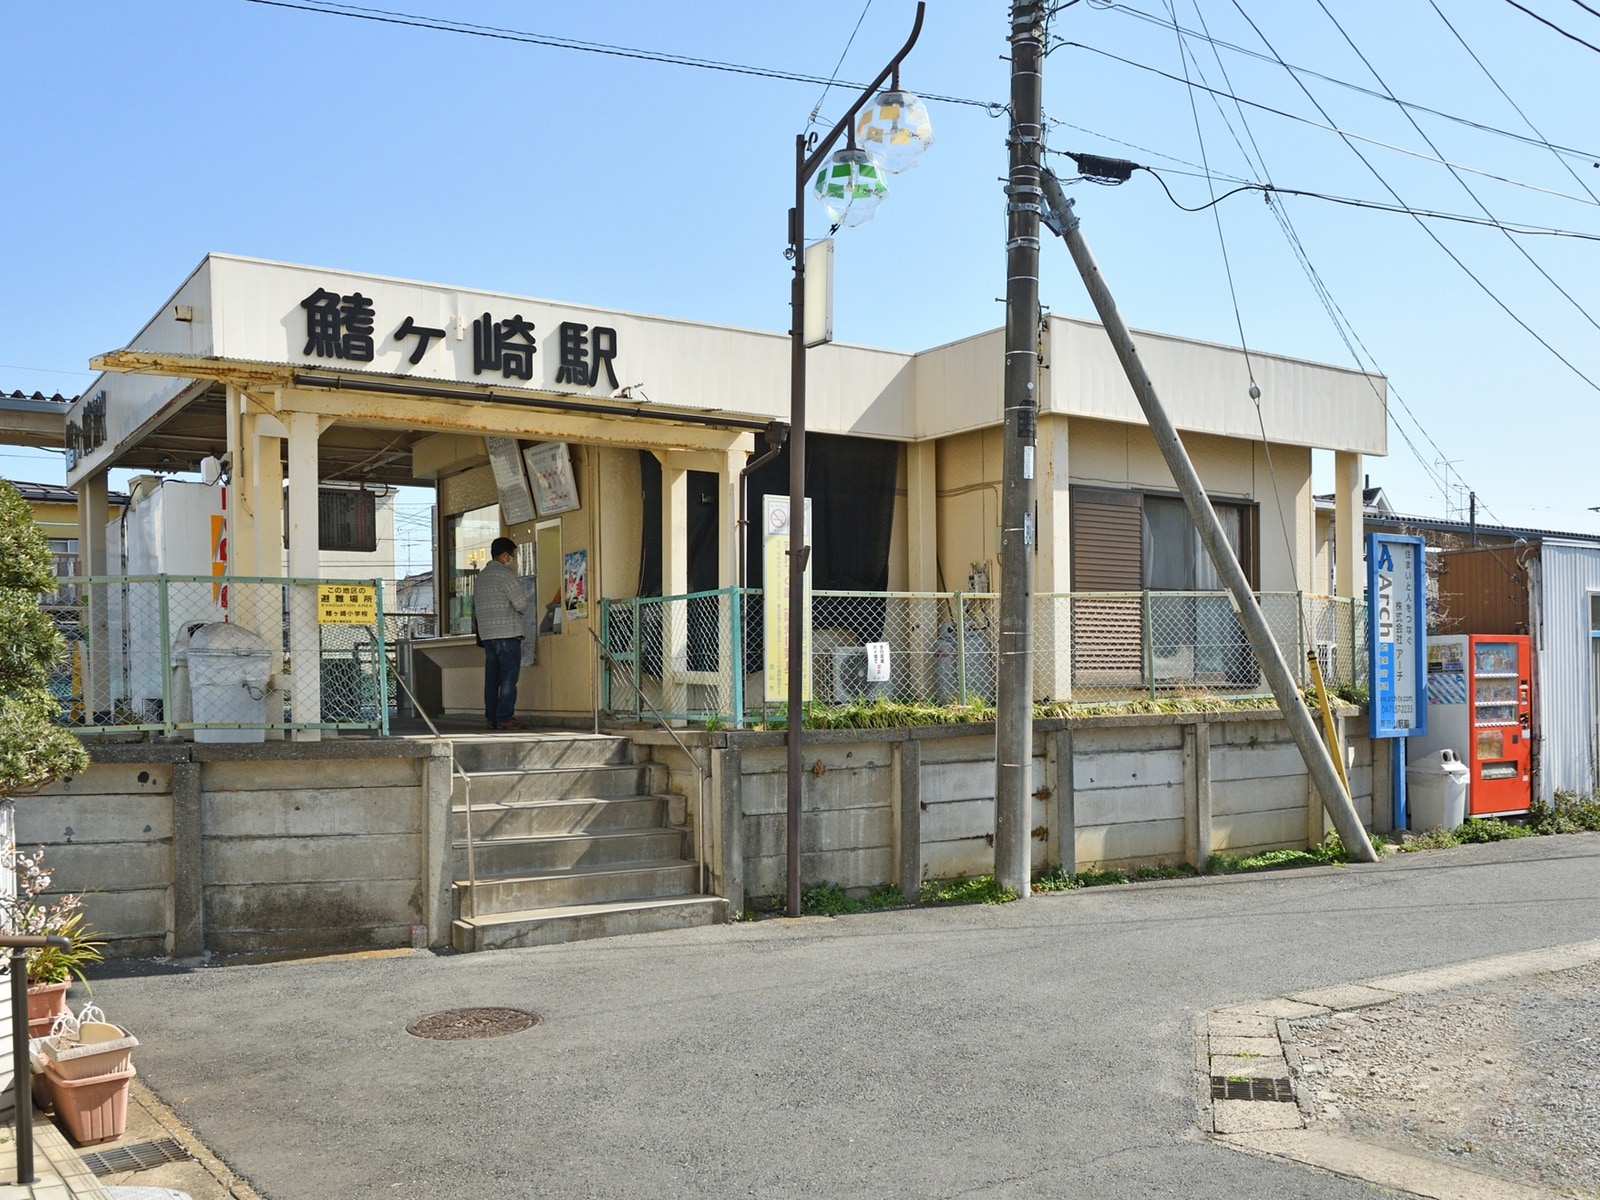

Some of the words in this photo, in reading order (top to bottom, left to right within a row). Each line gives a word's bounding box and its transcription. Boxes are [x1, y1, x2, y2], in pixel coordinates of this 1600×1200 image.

[321, 594, 373, 603] 避難場所
[1379, 573, 1393, 637] Arch
[1404, 550, 1413, 645] 住まいと人をつなぐ
